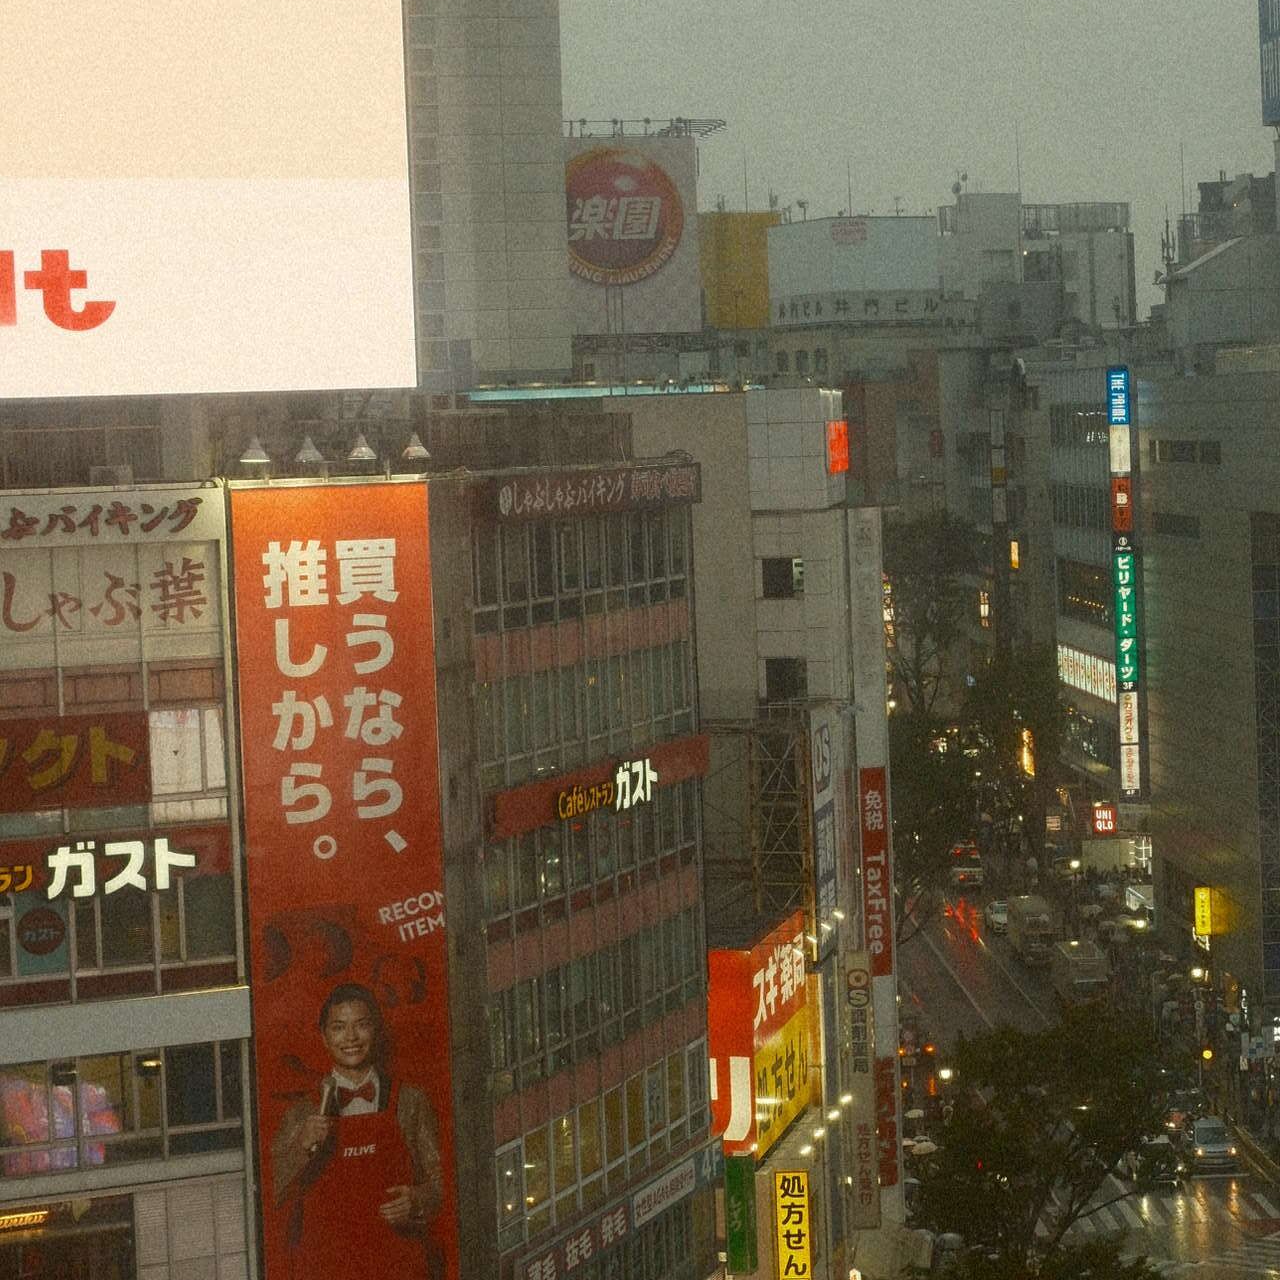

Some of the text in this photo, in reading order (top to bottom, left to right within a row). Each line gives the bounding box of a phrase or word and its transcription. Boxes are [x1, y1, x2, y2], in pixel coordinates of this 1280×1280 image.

[568, 194, 663, 241] 楽園
[2, 556, 208, 633] しゃぶ葉
[1116, 554, 1134, 681] ビリヤード・ダーツ
[261, 538, 338, 862] 推しから。
[334, 537, 409, 854] 買うなら、
[1122, 681, 1134, 690] 3F
[614, 757, 659, 813] ガスト
[1095, 809, 1112, 821] UNI
[1096, 821, 1113, 832] QLO
[46, 837, 197, 901] ガスト
[23, 927, 61, 943] ガスト
[752, 931, 806, 1031] スギ薬局
[343, 1142, 377, 1158] 17LIVE
[779, 1175, 807, 1276] 処方せん
